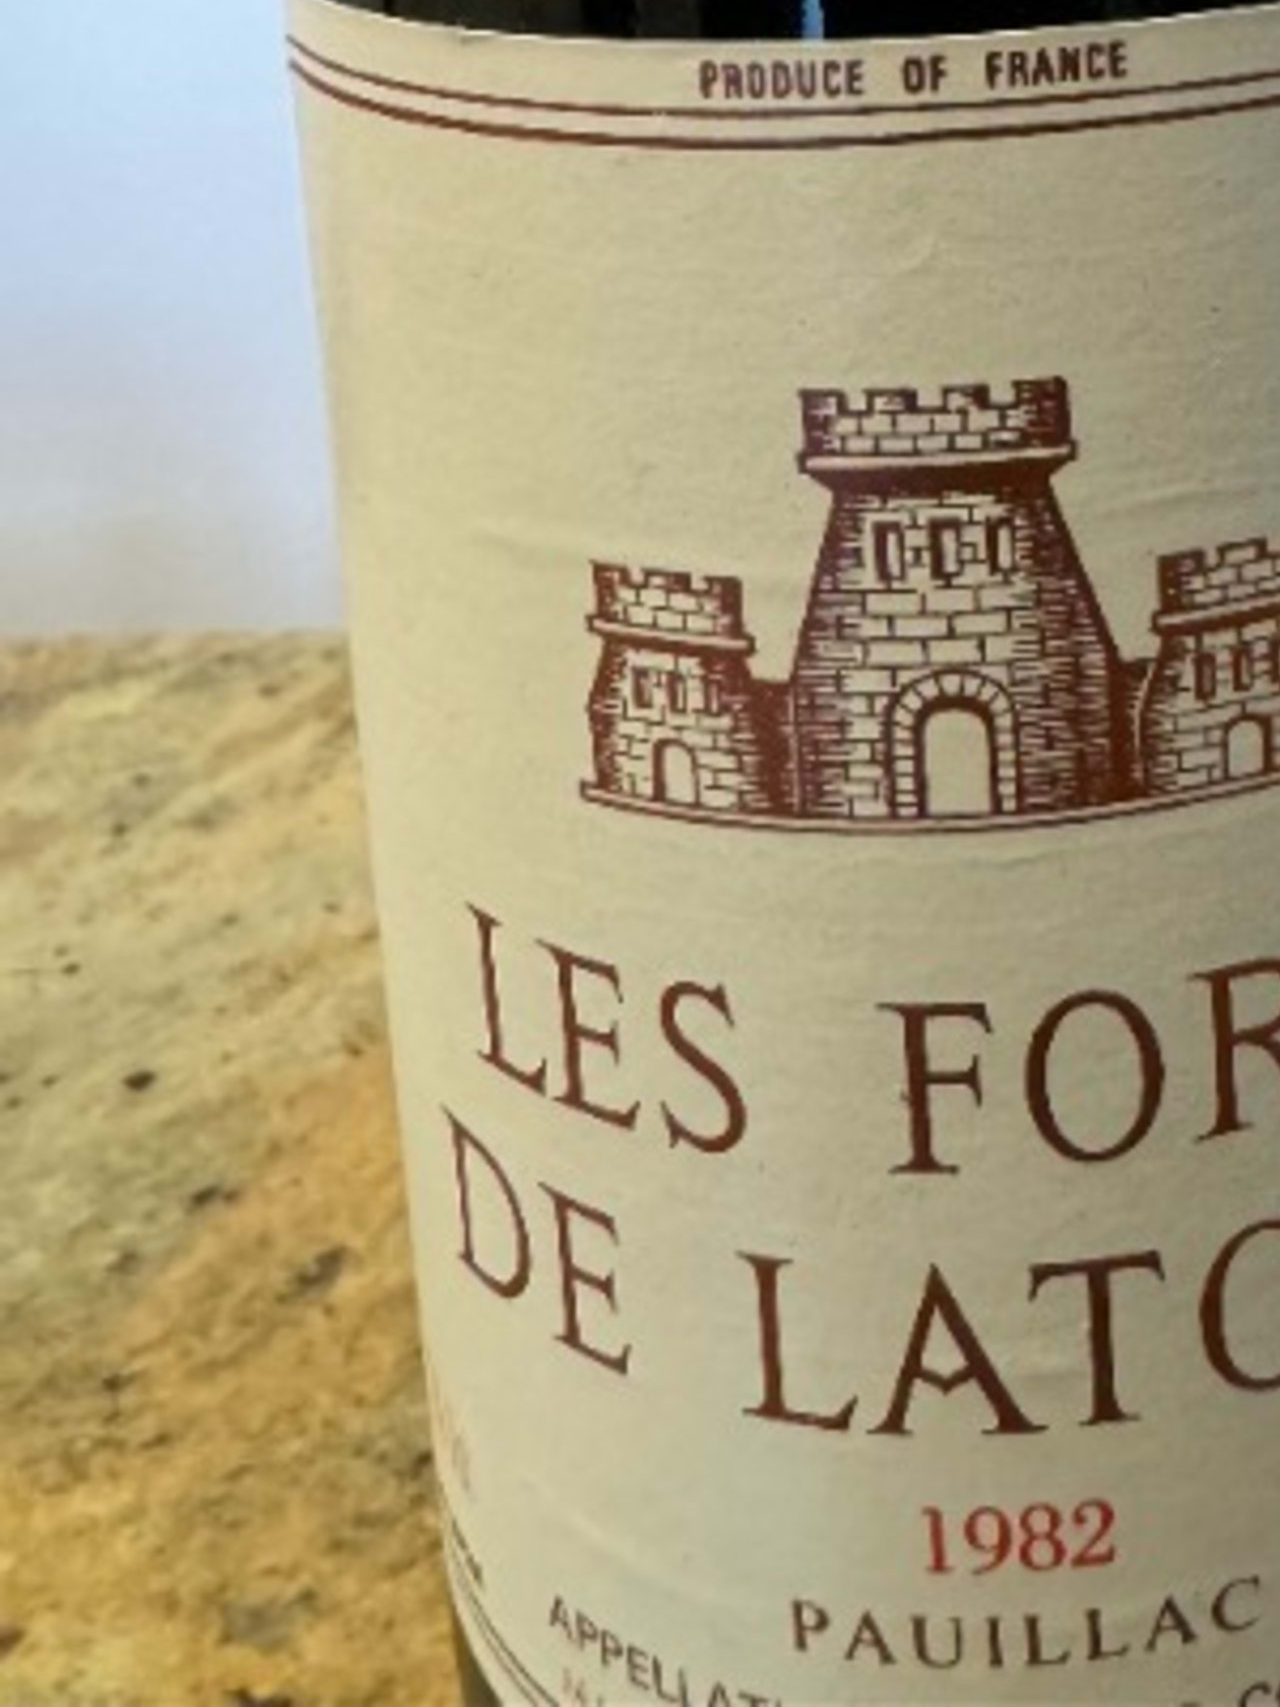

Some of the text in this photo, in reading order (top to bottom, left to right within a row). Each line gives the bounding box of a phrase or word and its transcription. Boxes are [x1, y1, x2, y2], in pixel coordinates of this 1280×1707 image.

[699, 40, 1128, 100] PRODUCE OF FRANCE
[465, 902, 748, 1155] LES
[440, 1102, 630, 1376] DE
[921, 1497, 1117, 1577] 1982
[791, 1575, 1262, 1669] PAUILLAC
